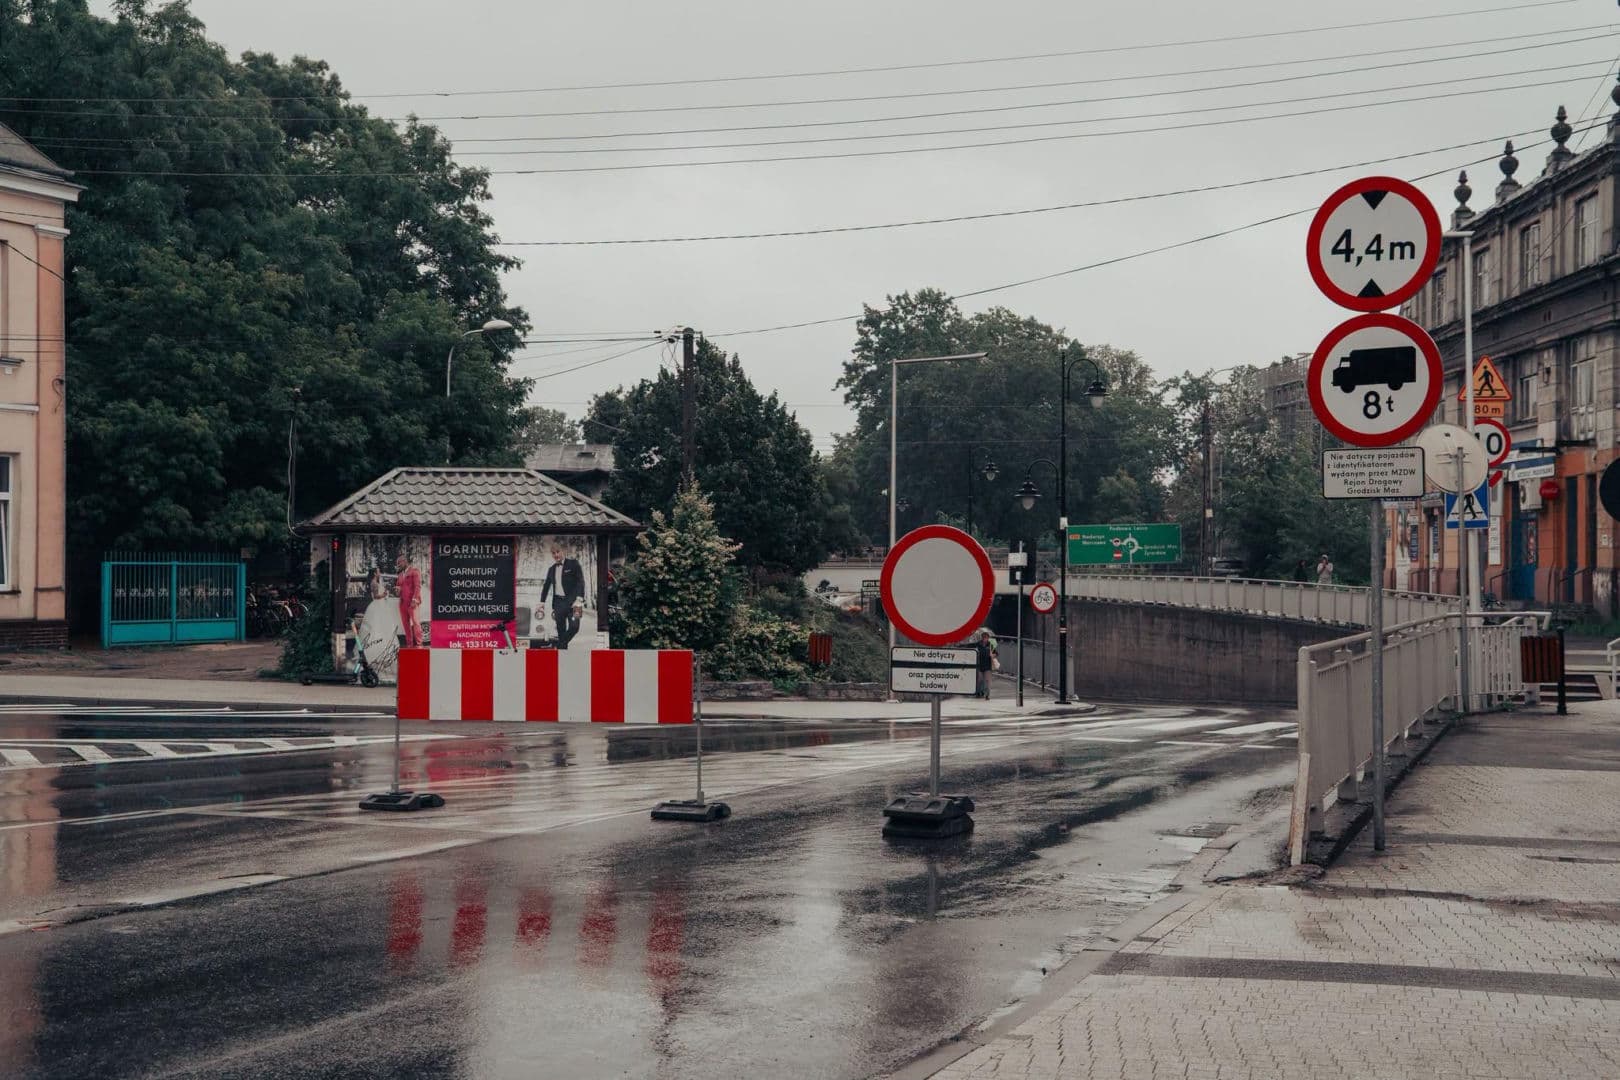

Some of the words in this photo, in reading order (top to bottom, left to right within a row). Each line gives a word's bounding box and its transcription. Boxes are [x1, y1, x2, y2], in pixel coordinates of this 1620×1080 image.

[1346, 453, 1375, 461] dotyczy
[1333, 461, 1395, 470] identyfikatorem
[1330, 471, 1366, 479] wydanym
[1391, 468, 1416, 476] MZDW
[1343, 478, 1366, 487] Rejon
[1368, 478, 1403, 487] Drogowy
[1347, 486, 1381, 494] Grodzisk
[449, 567, 498, 576] GARNITURY
[451, 580, 496, 588] SMOKINGI
[454, 592, 493, 600] KOSZULE
[438, 605, 476, 613] DODATKI
[478, 605, 509, 614] MĘSKIE
[449, 640, 465, 648] lok.
[927, 650, 956, 661] dotyczy
[919, 681, 948, 691] budowy
